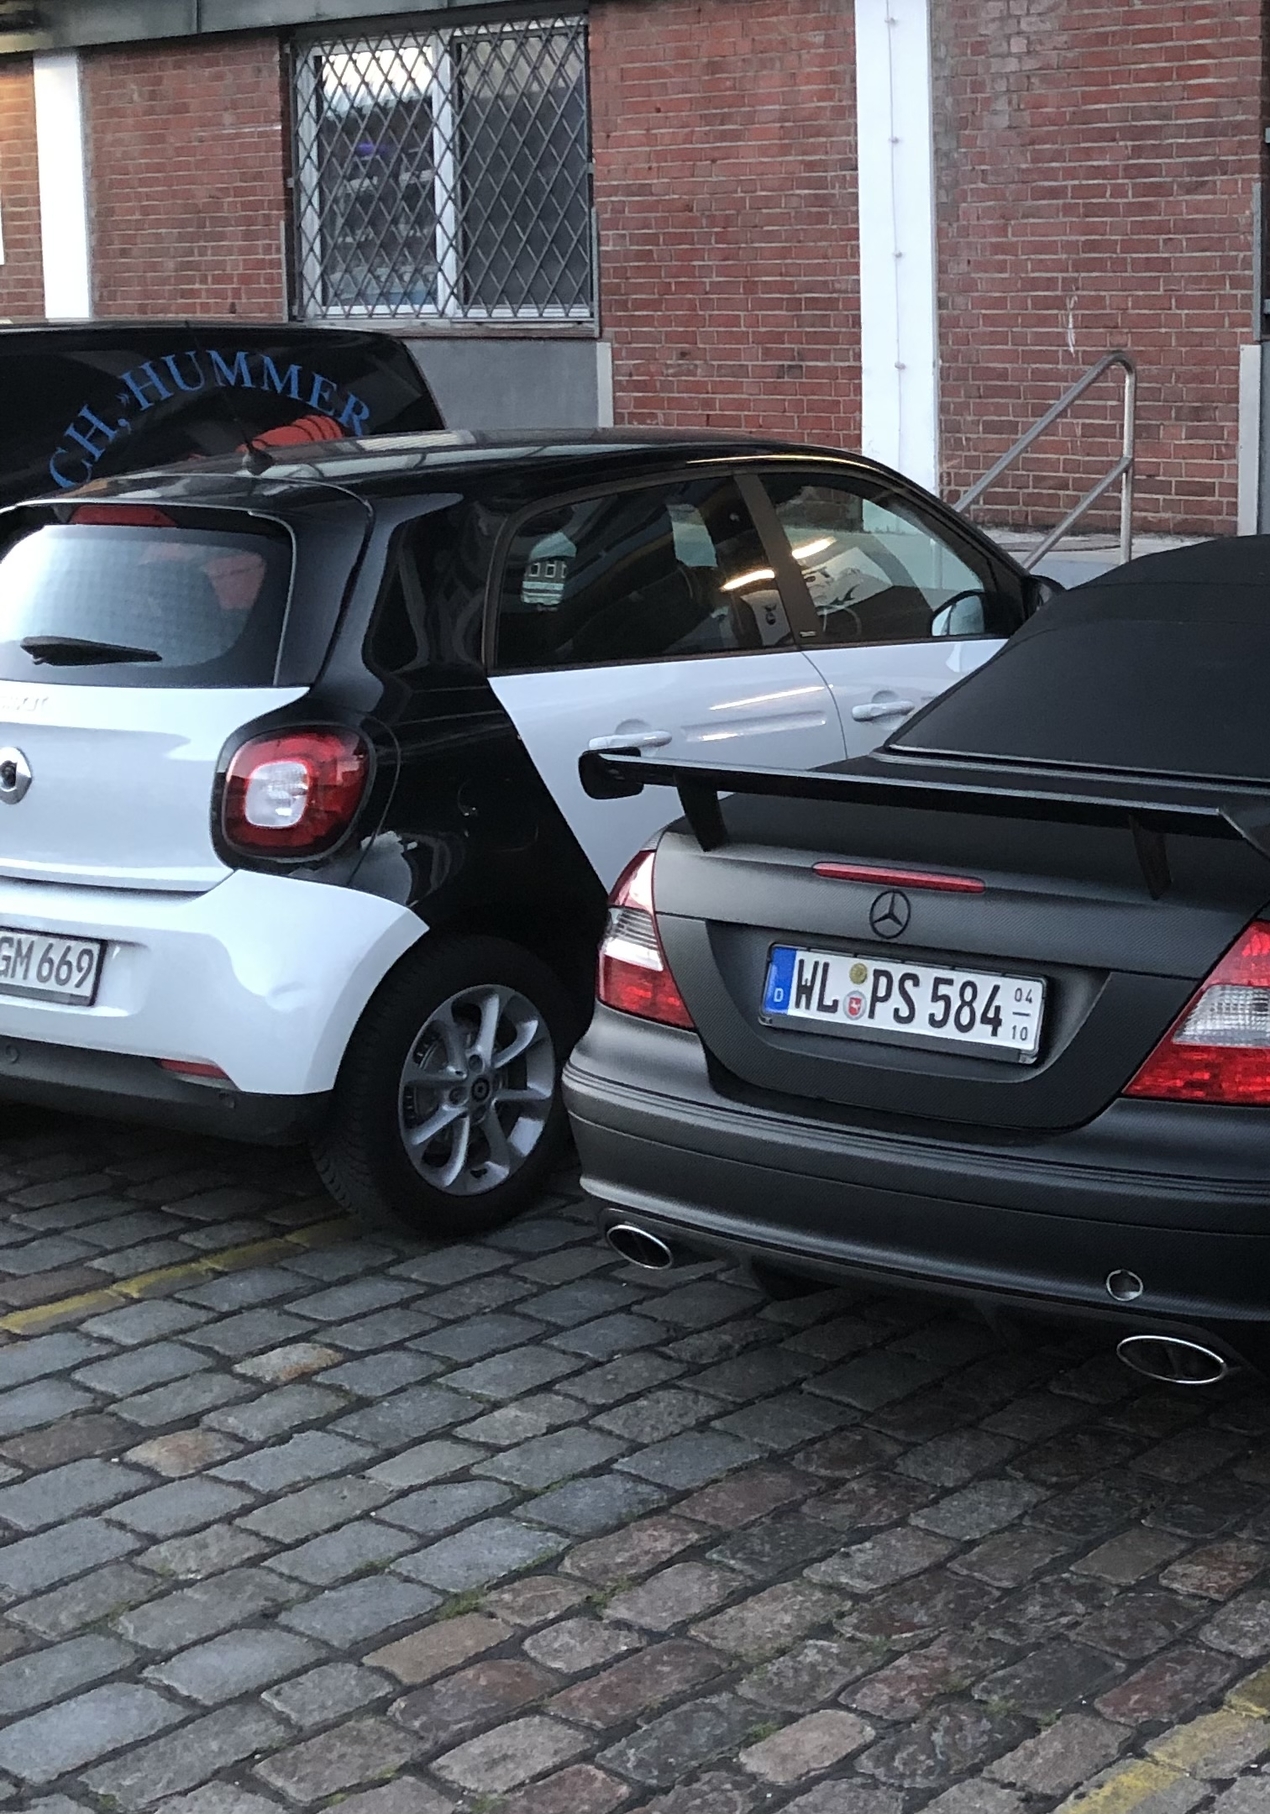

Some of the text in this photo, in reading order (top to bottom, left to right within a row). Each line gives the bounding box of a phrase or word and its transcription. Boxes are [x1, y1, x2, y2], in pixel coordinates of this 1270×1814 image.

[117, 349, 369, 437] HUMMER
[36, 942, 94, 988] 669
[773, 987, 783, 1003] D
[794, 958, 1003, 1037] WL PS 584
[1014, 987, 1033, 1003] 04
[1012, 1025, 1028, 1041] 10
